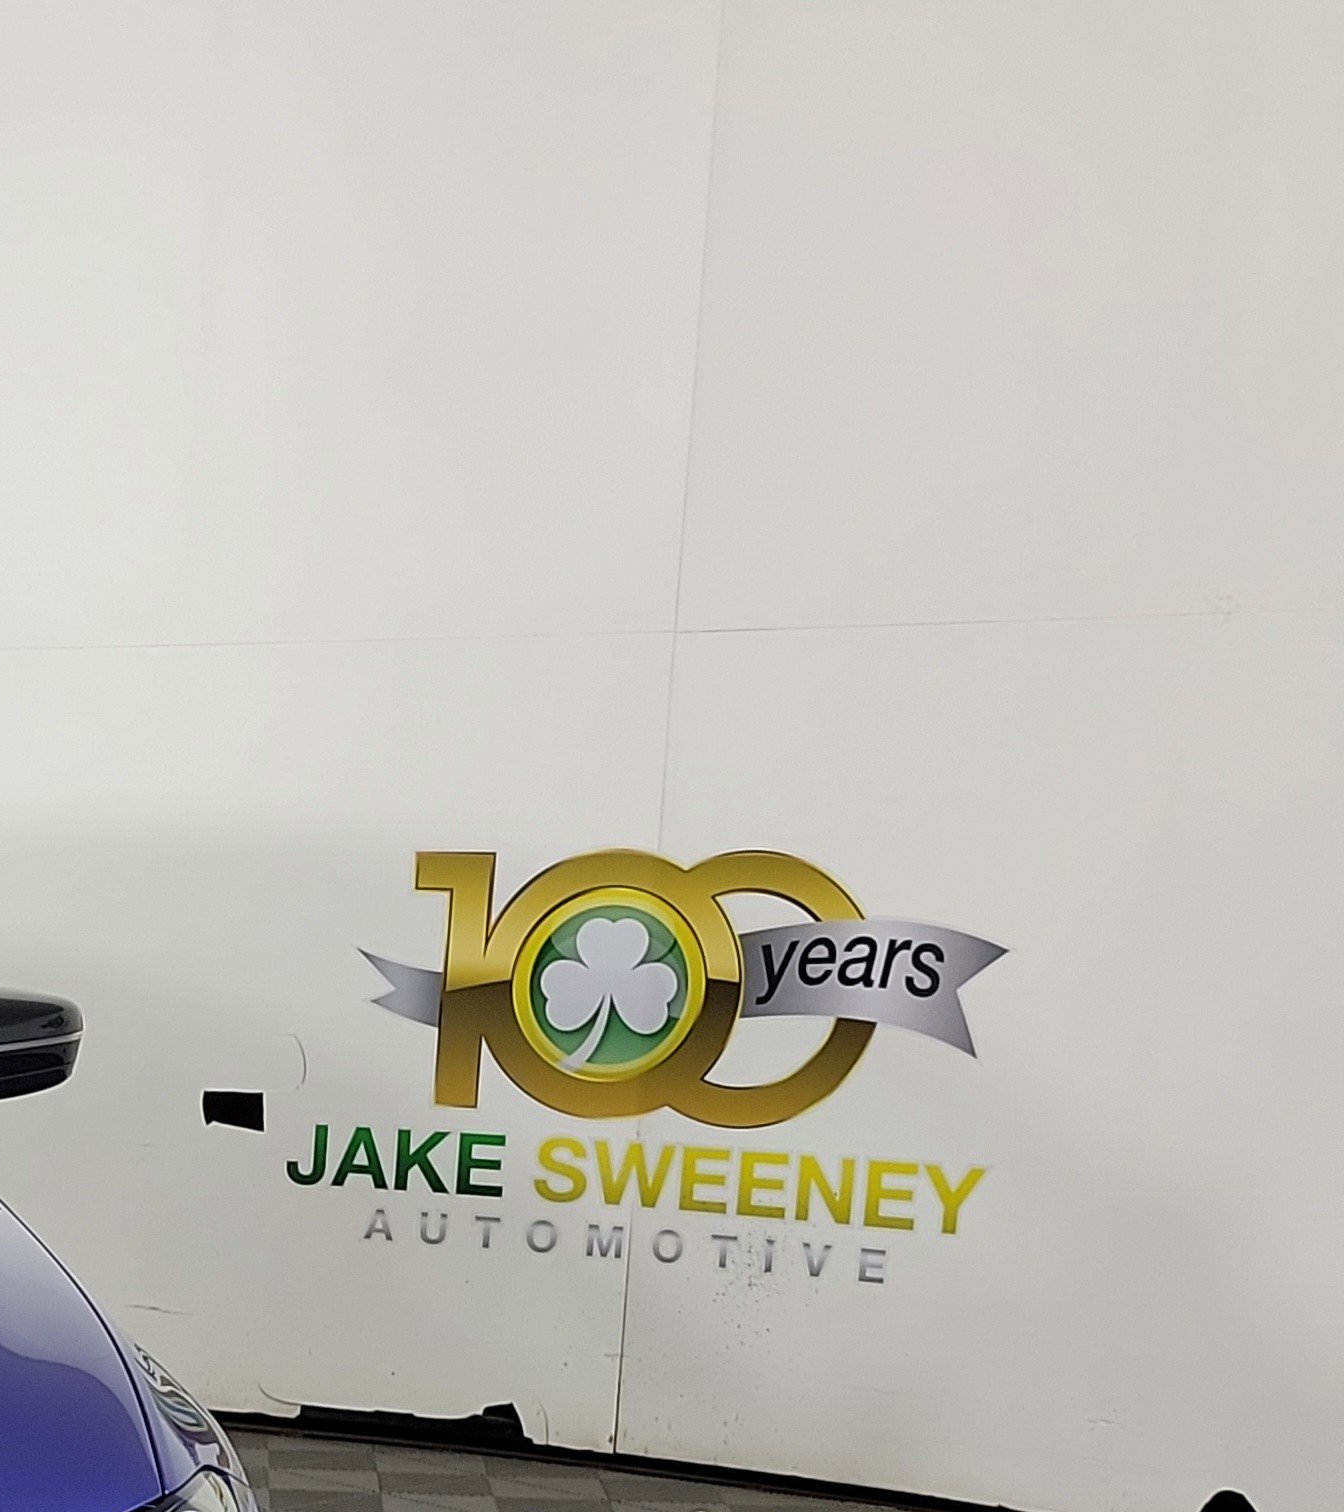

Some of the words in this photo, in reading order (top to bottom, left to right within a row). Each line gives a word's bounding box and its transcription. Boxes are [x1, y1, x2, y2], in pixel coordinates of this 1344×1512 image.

[415, 849, 876, 1129] 100
[755, 936, 946, 1006] years
[286, 1124, 507, 1198] JAKE
[533, 1136, 988, 1236] SWEENEY
[363, 1208, 887, 1285] AUTOMOTIVE
